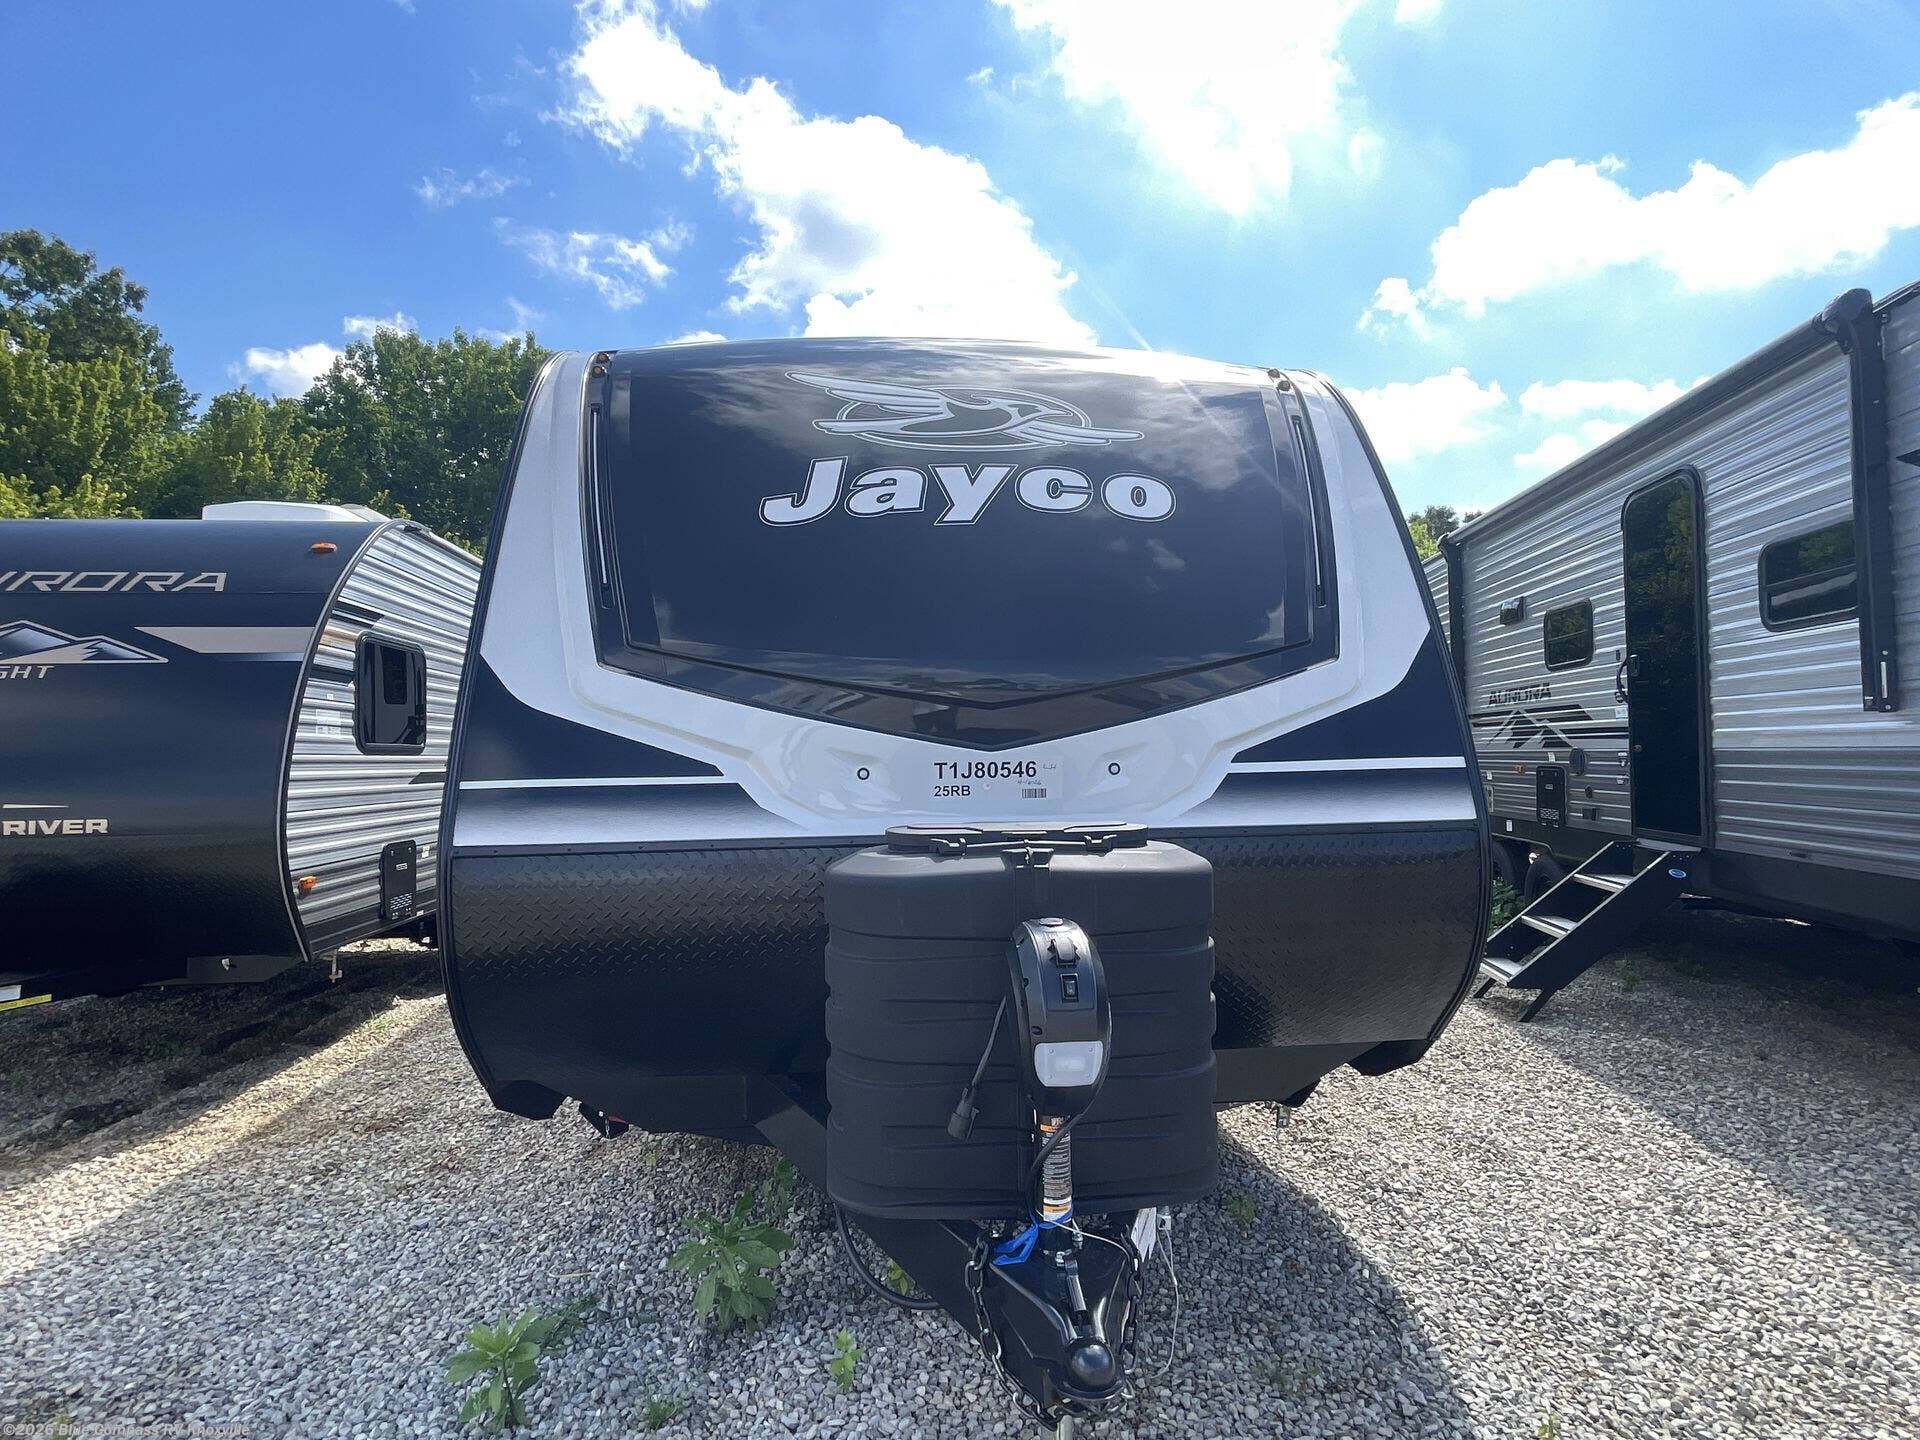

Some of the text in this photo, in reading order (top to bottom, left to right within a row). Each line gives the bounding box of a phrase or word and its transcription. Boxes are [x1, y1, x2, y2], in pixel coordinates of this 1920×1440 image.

[759, 456, 1176, 527] Jayco
[934, 761, 1037, 779] T1J80546
[934, 785, 971, 797] 25RB
[2, 818, 109, 836] RIVER
